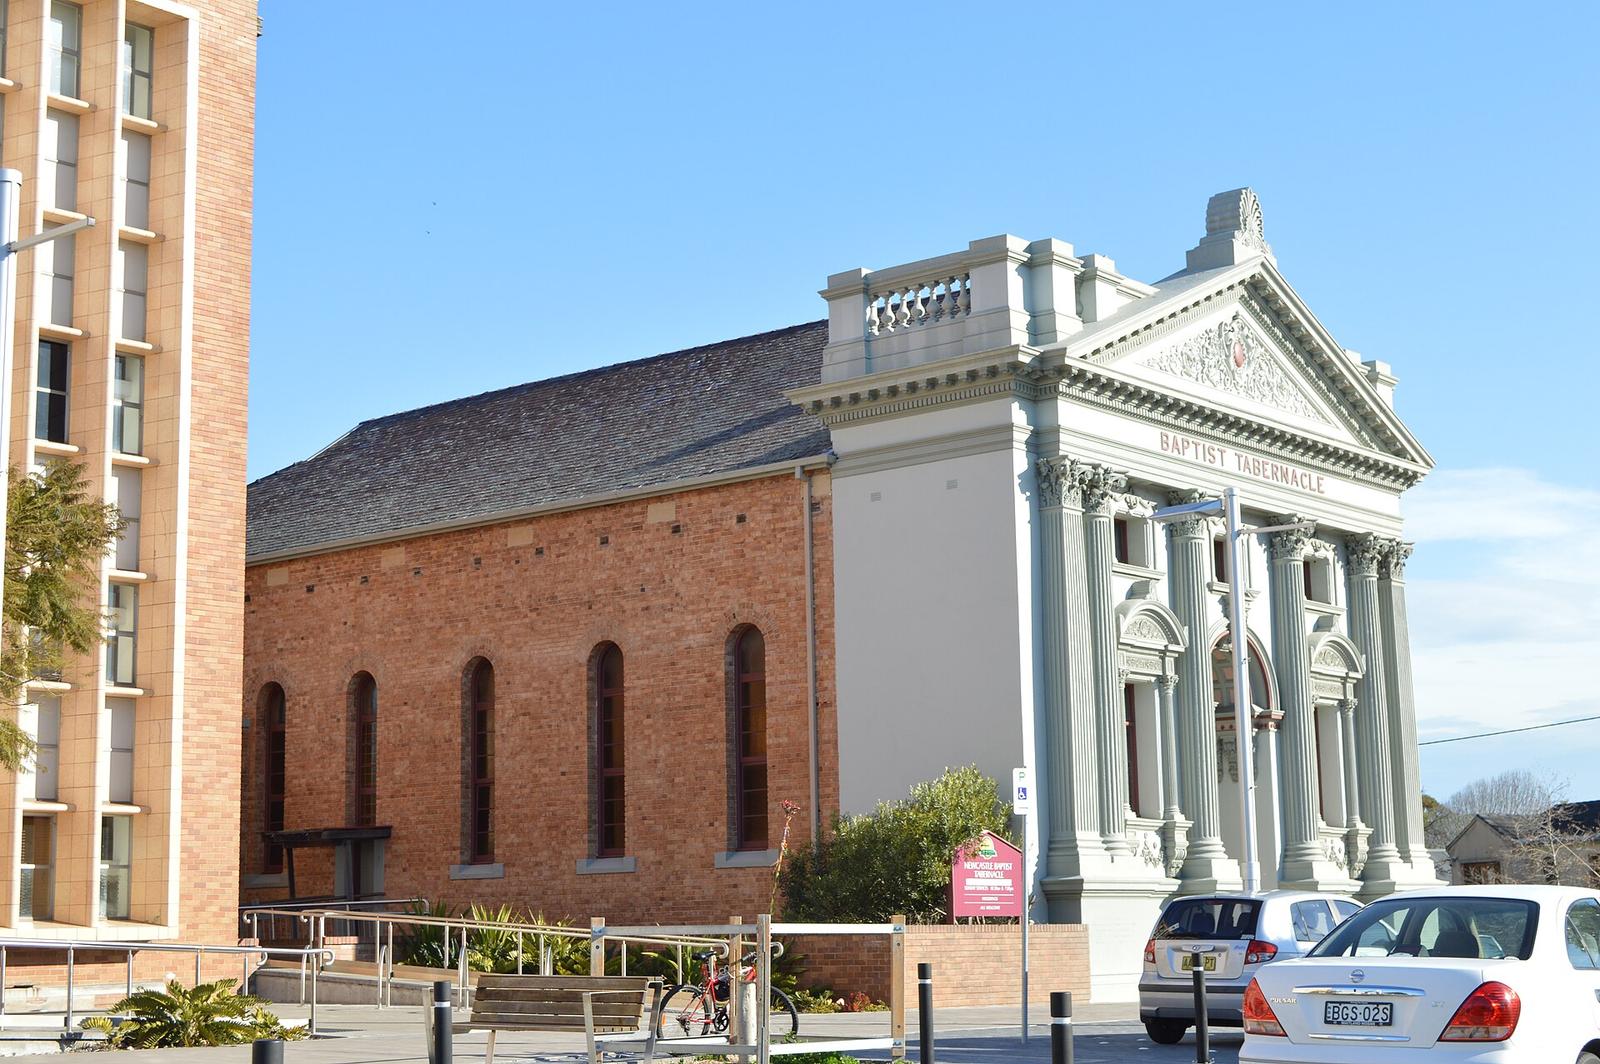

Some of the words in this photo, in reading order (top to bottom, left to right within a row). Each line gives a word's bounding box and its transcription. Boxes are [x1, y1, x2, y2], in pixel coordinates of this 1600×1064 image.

[1160, 431, 1227, 467] BAPTIST
[1234, 451, 1325, 495] TABERNACLE
[964, 861, 993, 870] NEWCASTLE
